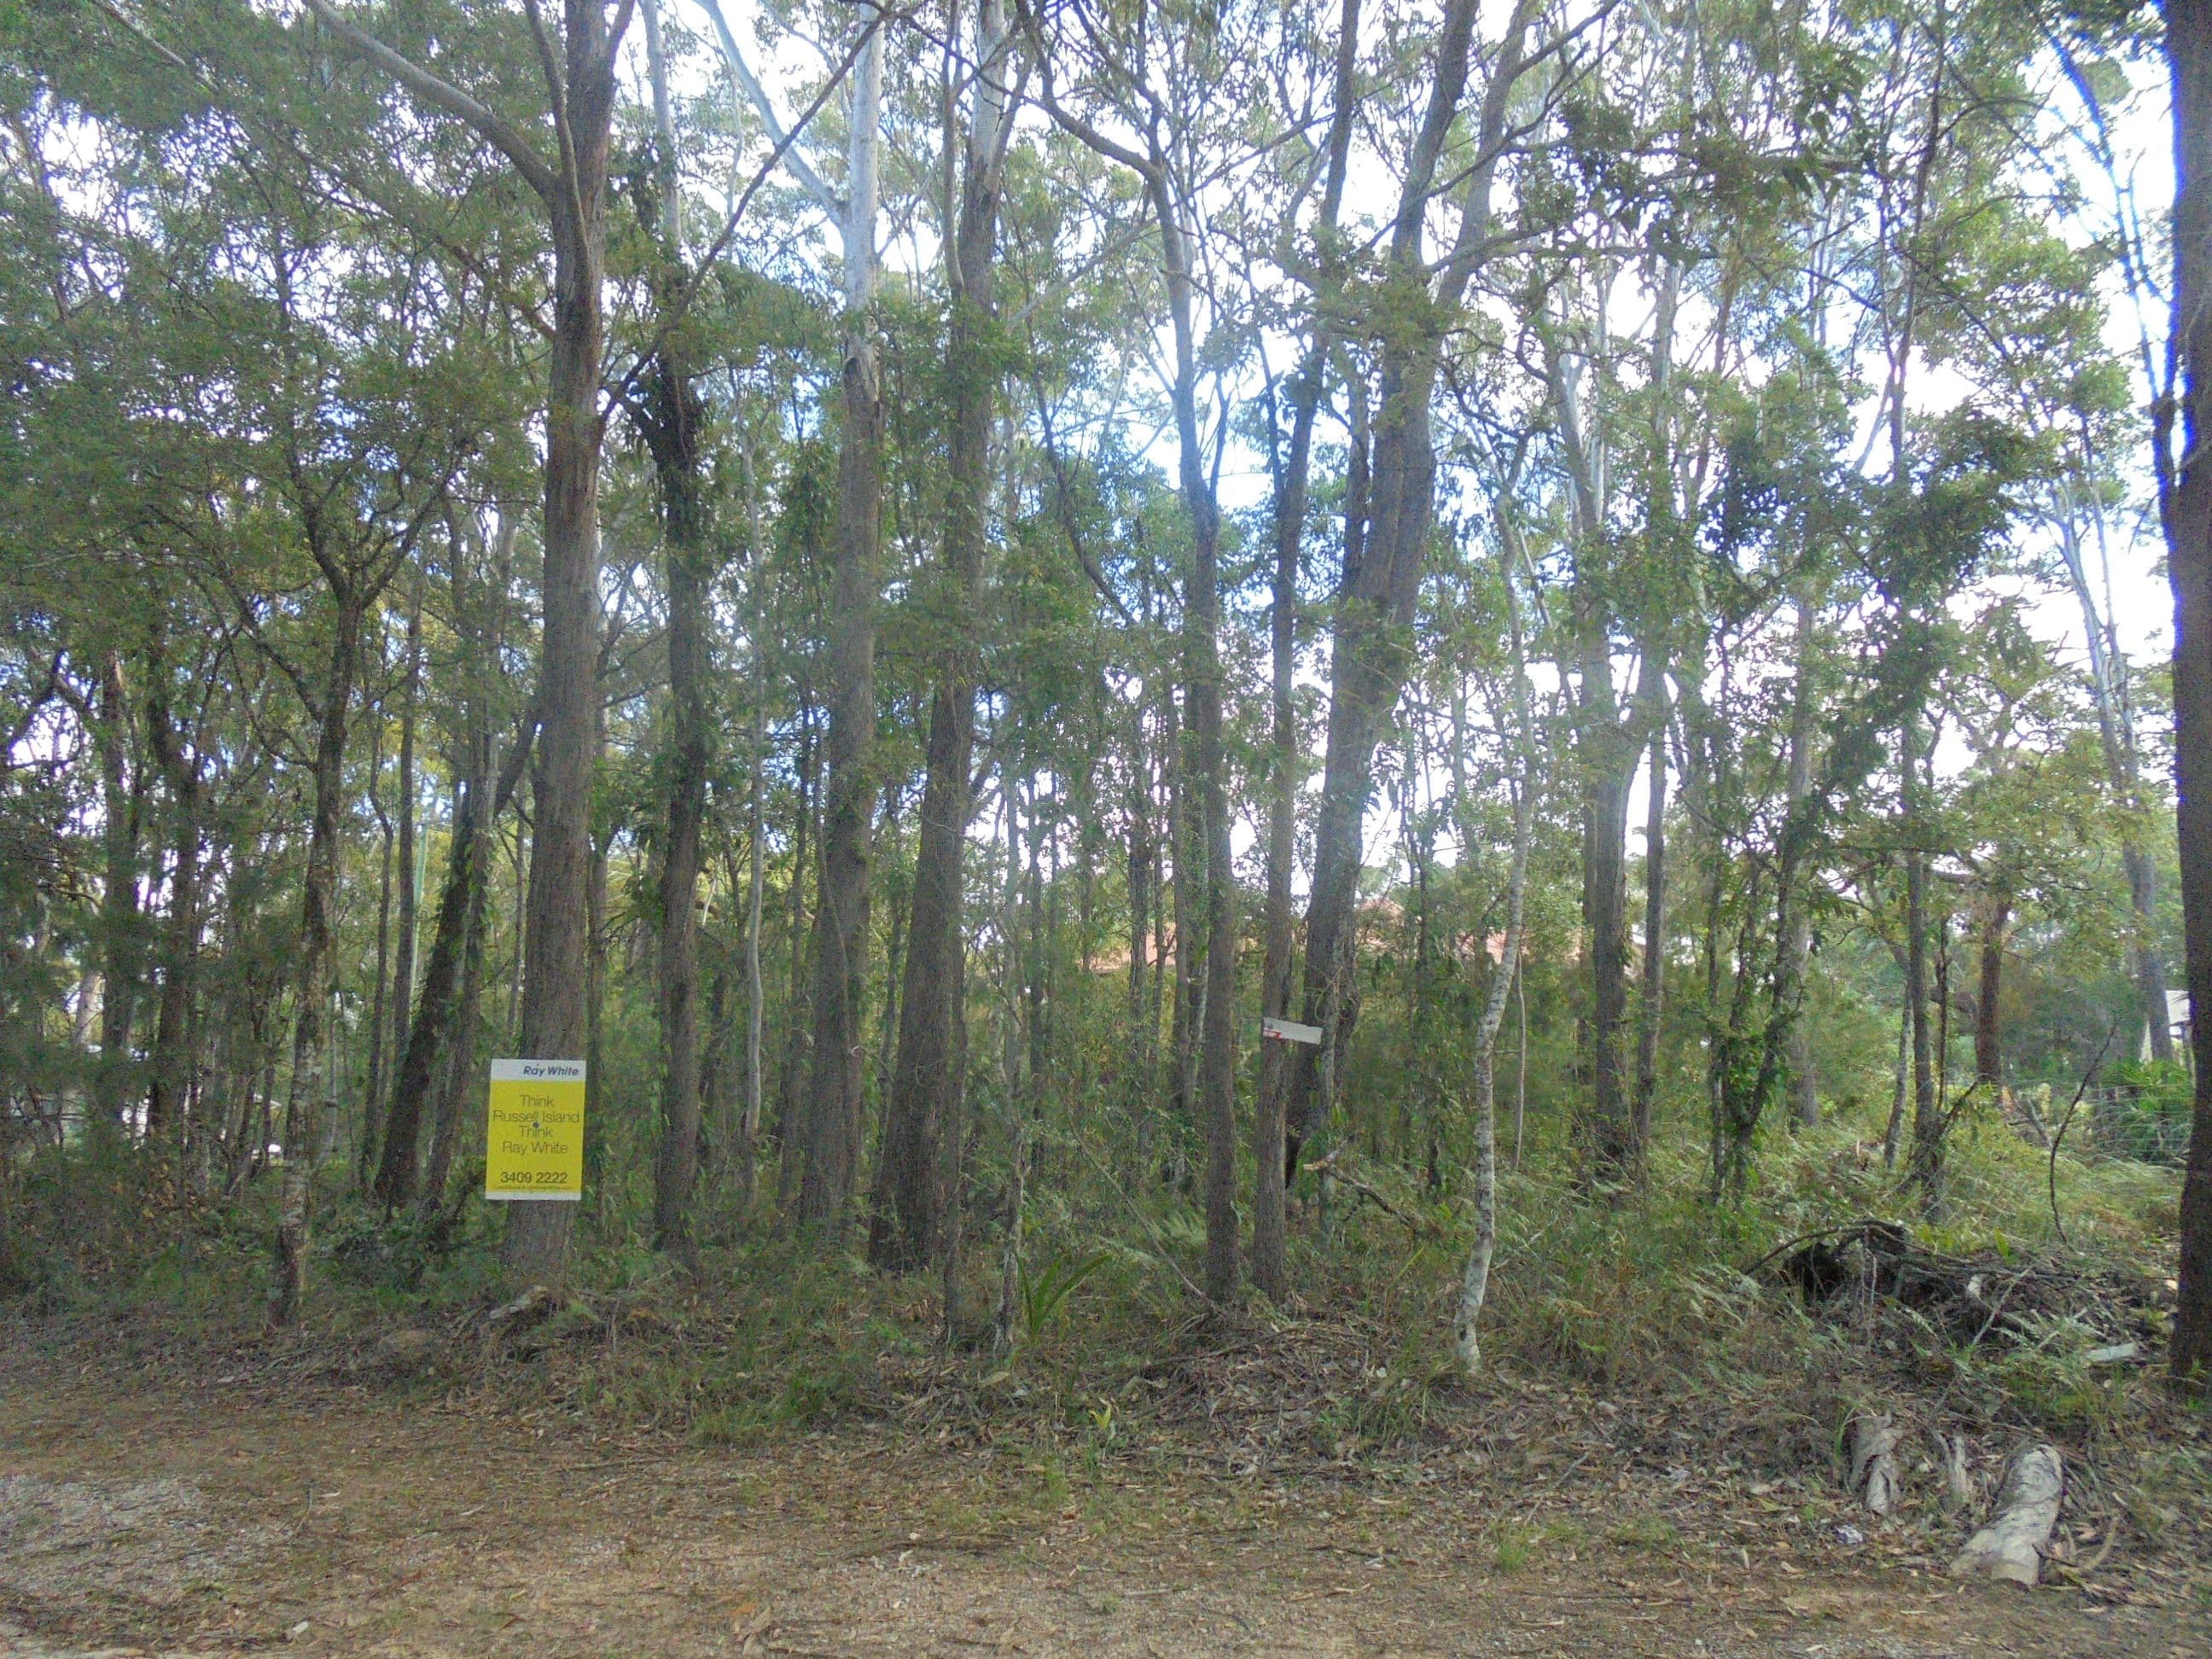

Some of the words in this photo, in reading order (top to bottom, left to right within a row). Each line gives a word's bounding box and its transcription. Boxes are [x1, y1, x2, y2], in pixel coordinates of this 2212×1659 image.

[523, 1066, 544, 1077] Ray
[547, 1066, 579, 1075] White
[520, 1095, 554, 1107] Think
[493, 1110, 538, 1122] Russell
[543, 1110, 579, 1123] Island
[519, 1126, 553, 1138] Think
[503, 1141, 527, 1155] Ray
[532, 1141, 568, 1154] White
[500, 1173, 532, 1184] 3409
[536, 1173, 568, 1184] 2222
